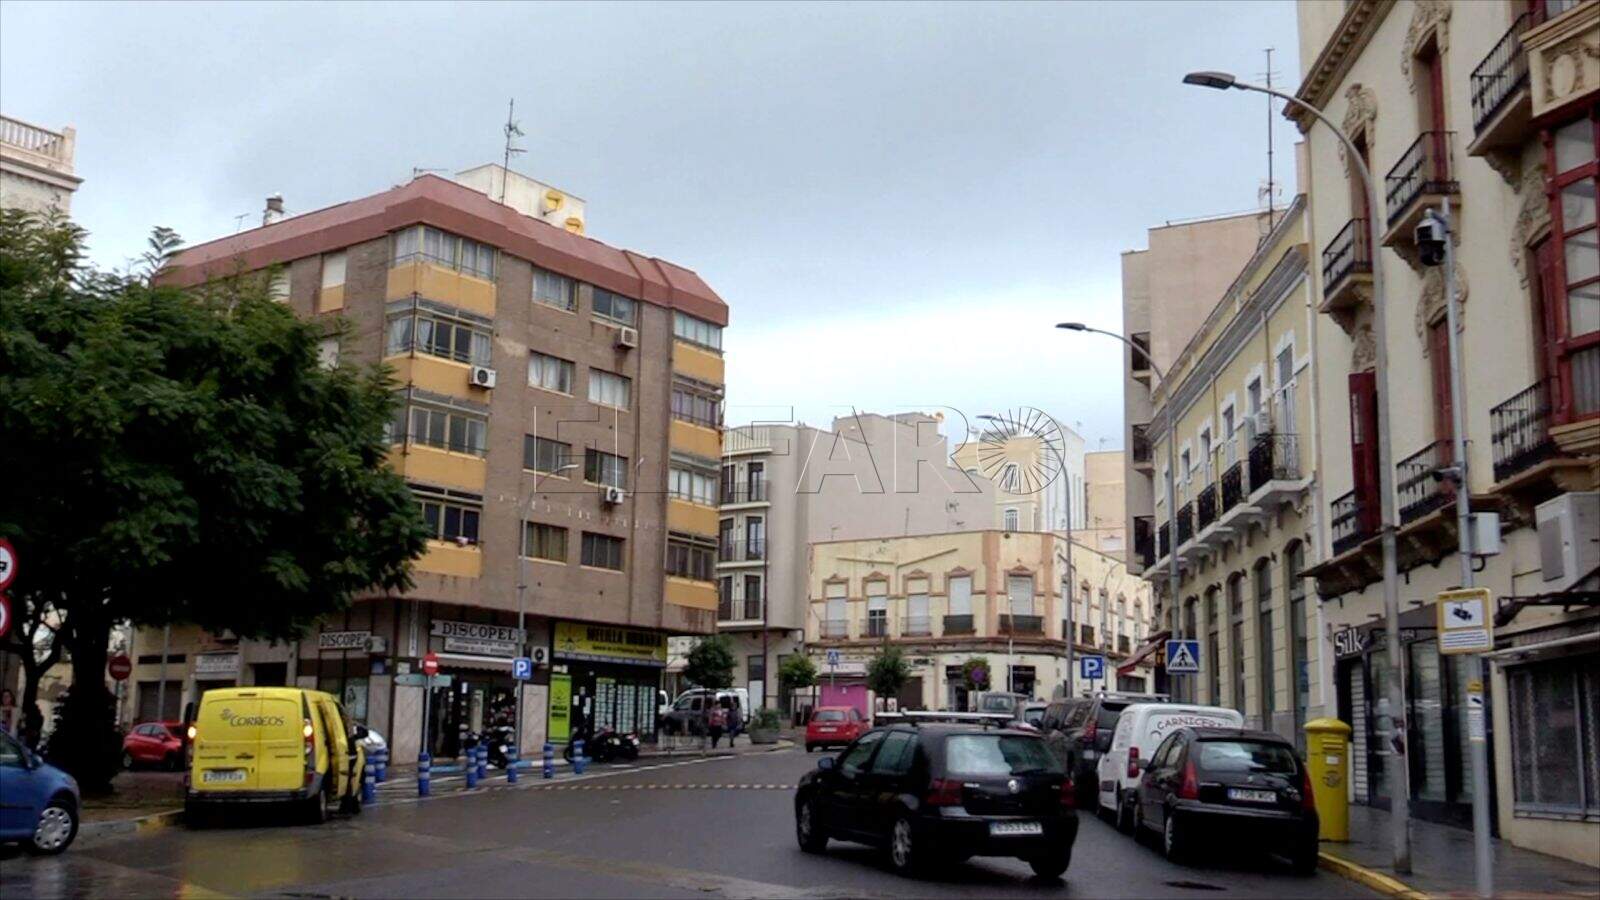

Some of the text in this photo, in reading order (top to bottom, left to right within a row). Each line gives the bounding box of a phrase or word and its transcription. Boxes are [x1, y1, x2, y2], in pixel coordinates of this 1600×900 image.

[442, 622, 516, 641] DISCOPEL
[1335, 629, 1363, 657] Silk
[516, 661, 527, 677] P
[1084, 659, 1099, 677] P
[230, 716, 285, 728] CORREOS
